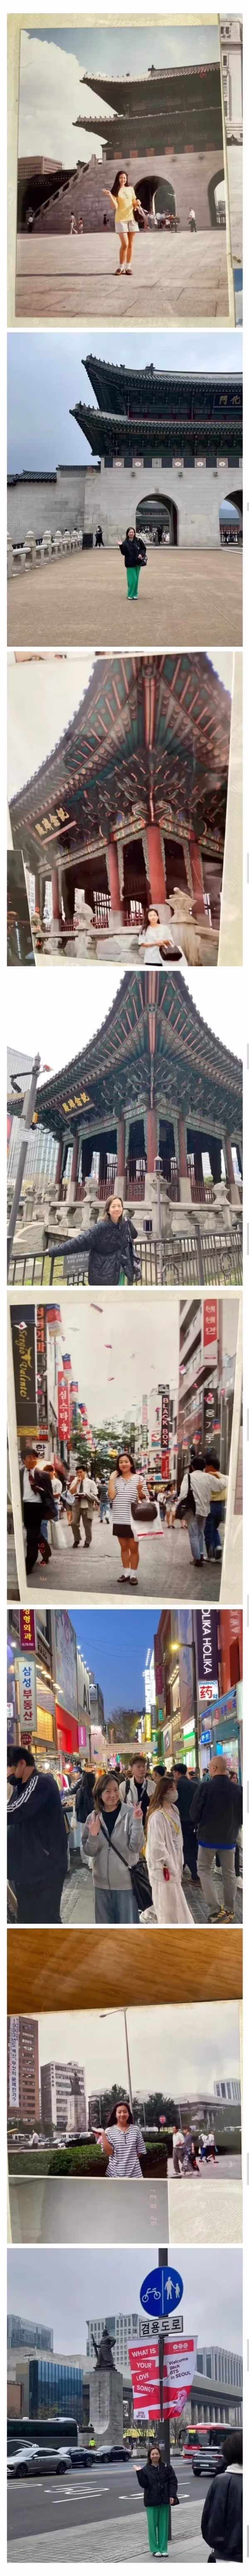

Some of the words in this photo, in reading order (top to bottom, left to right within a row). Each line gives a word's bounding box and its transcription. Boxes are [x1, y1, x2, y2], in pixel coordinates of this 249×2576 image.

[15, 1330, 27, 1354] Sergio
[20, 1362, 31, 1397] Valente
[203, 1638, 212, 1674] HOLIKA
[22, 1666, 33, 1721] 삼성부동산
[200, 1686, 212, 1698] 药
[142, 2319, 181, 2335] 겸용도로
[168, 2357, 188, 2365] Welcome
[136, 2372, 149, 2381] LOVE
[44, 2486, 110, 2495] 50
